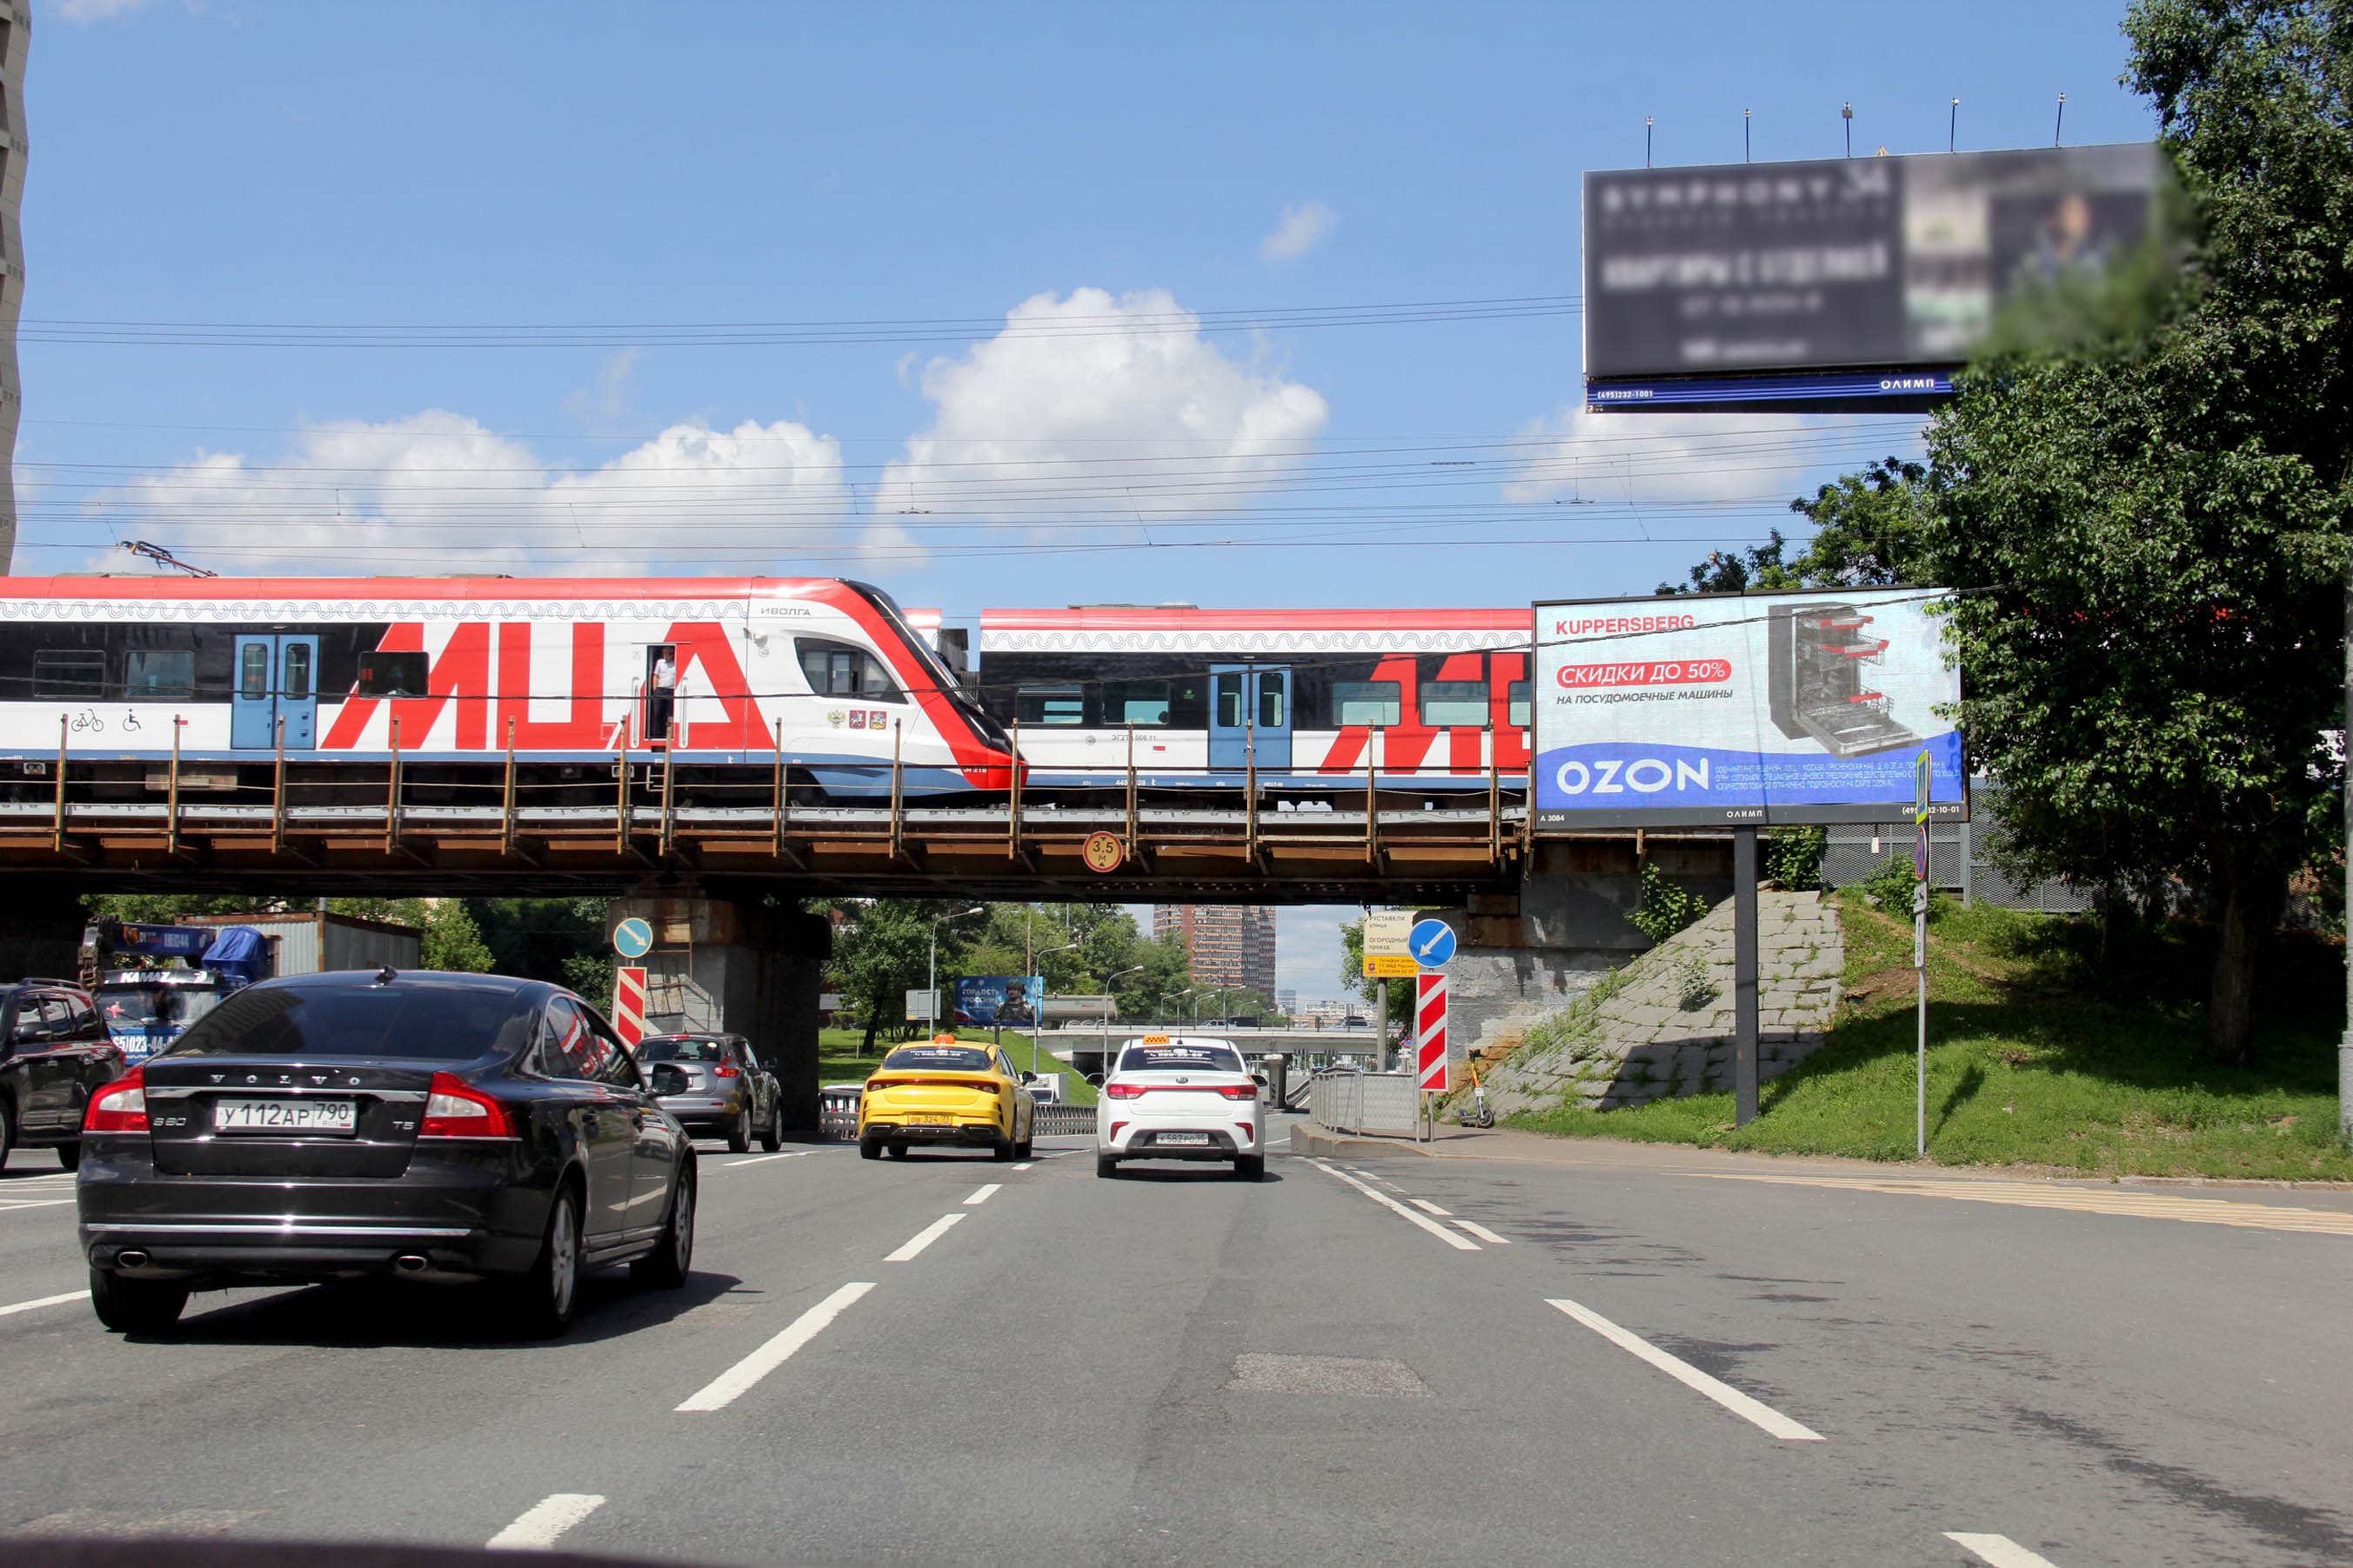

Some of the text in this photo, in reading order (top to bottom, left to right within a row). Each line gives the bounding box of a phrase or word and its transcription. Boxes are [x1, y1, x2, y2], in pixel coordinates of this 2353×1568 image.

[1881, 377, 1935, 390] ОЛИМП
[1597, 390, 1653, 399] (495)232-1001
[760, 607, 811, 616] ИВОЛГА
[1555, 614, 1695, 635] KUPPERSBERG
[1561, 661, 1726, 684] СКИДКИ ДО 50%
[1556, 689, 1734, 705] НА ПОСУДОМОЕЧНЫЕ МАШИНЫ
[1556, 757, 1709, 795] OZON
[1726, 810, 1762, 818] ОЛИМП
[120, 971, 171, 984] KAMAZ
[210, 1074, 361, 1085] VOLVO
[316, 1103, 349, 1120] 790
[392, 1120, 415, 1130] T5
